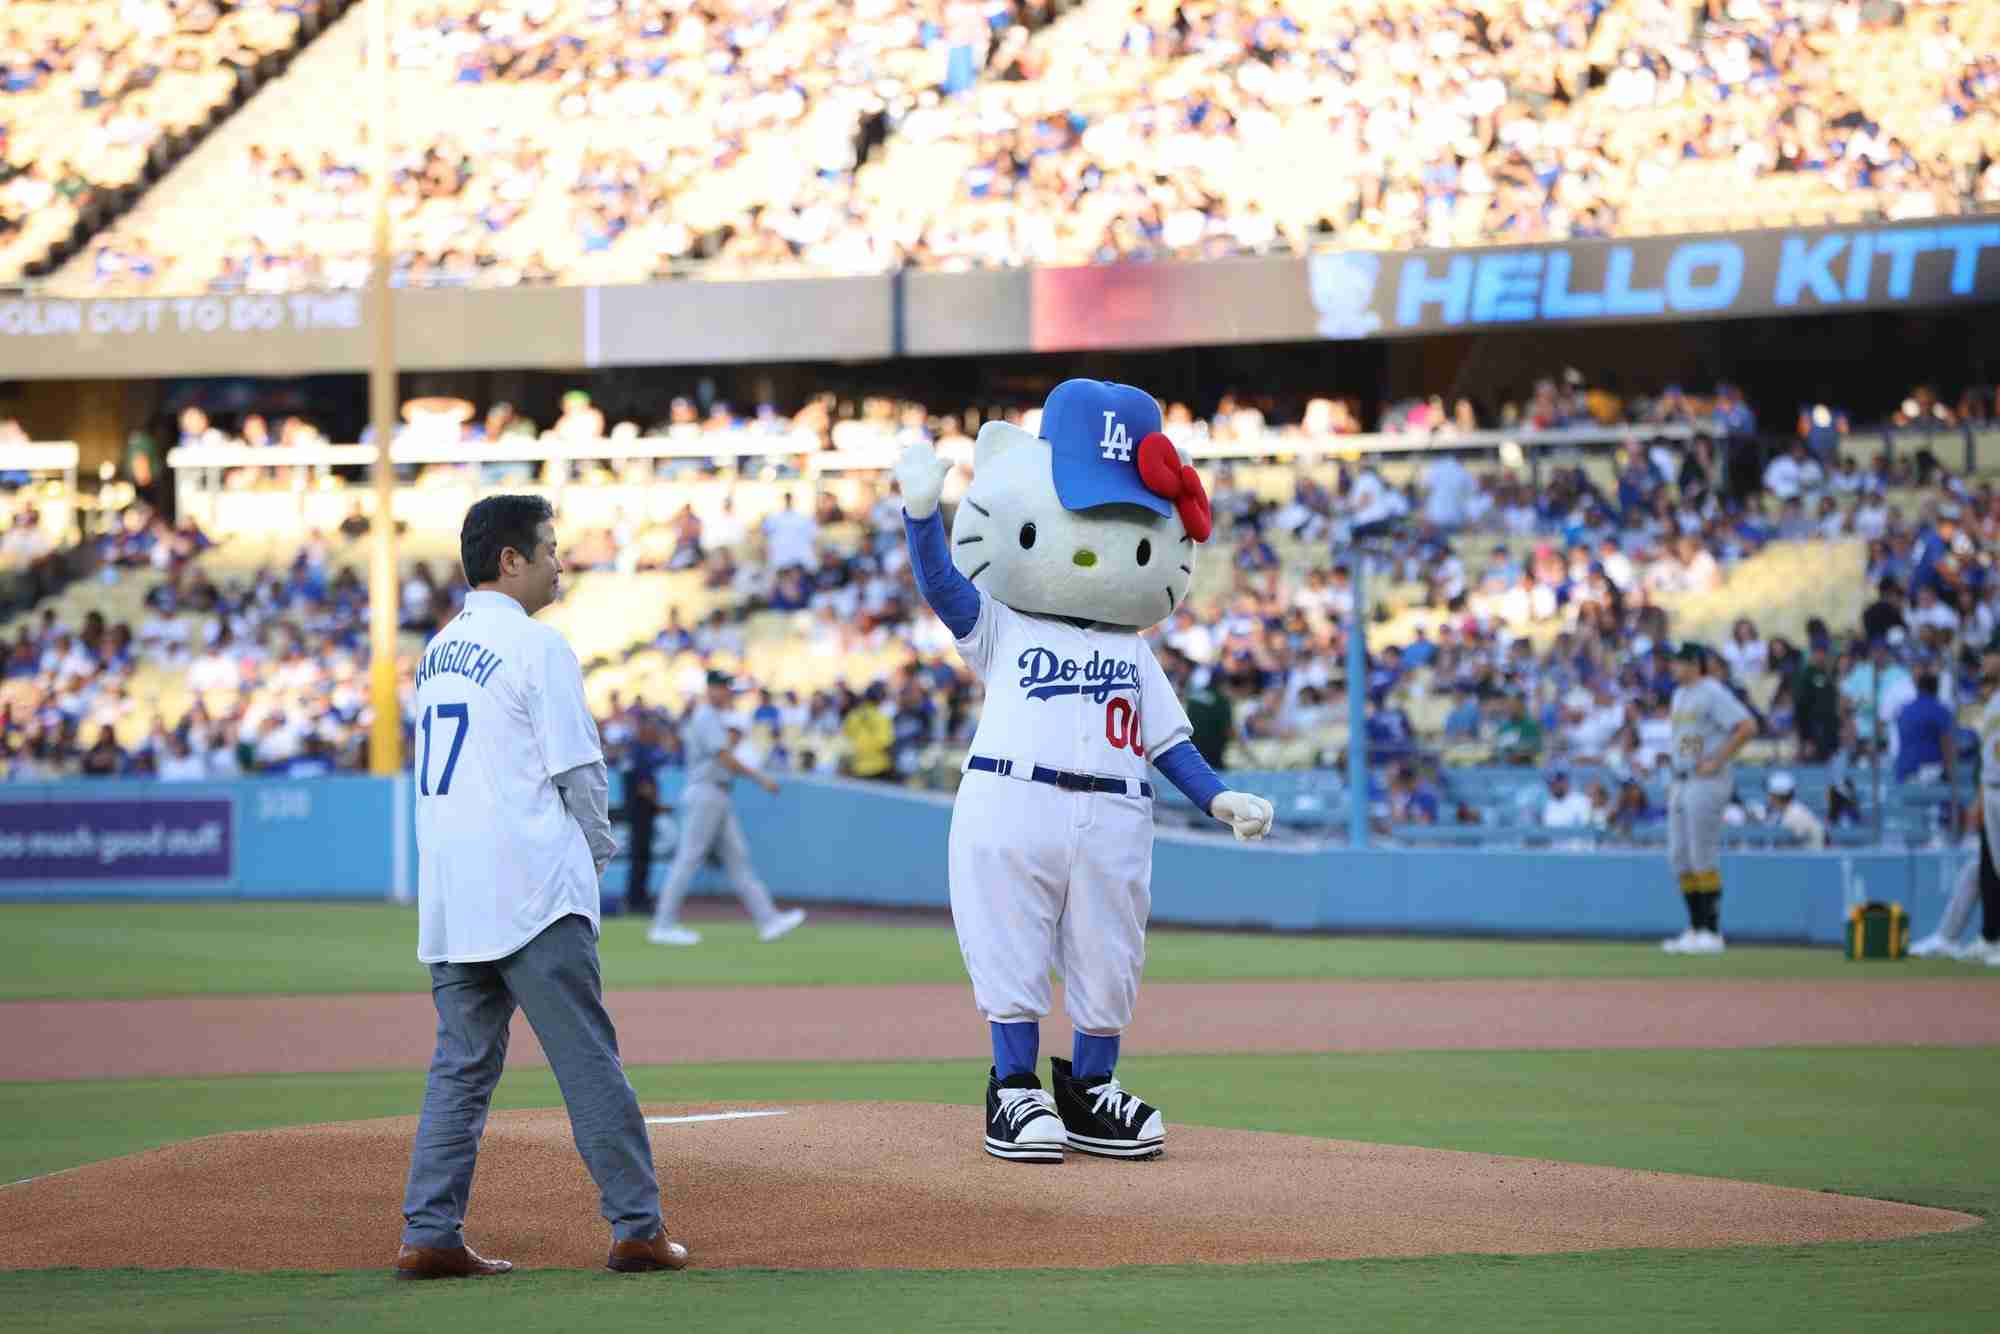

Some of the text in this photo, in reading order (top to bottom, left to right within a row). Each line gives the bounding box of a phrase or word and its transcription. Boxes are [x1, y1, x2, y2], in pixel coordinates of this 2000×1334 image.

[1394, 222, 2000, 327] HELLO KITT
[89, 301, 161, 334] OUT
[174, 299, 224, 331] TO
[1100, 411, 1133, 461] LA
[421, 703, 469, 796] 17
